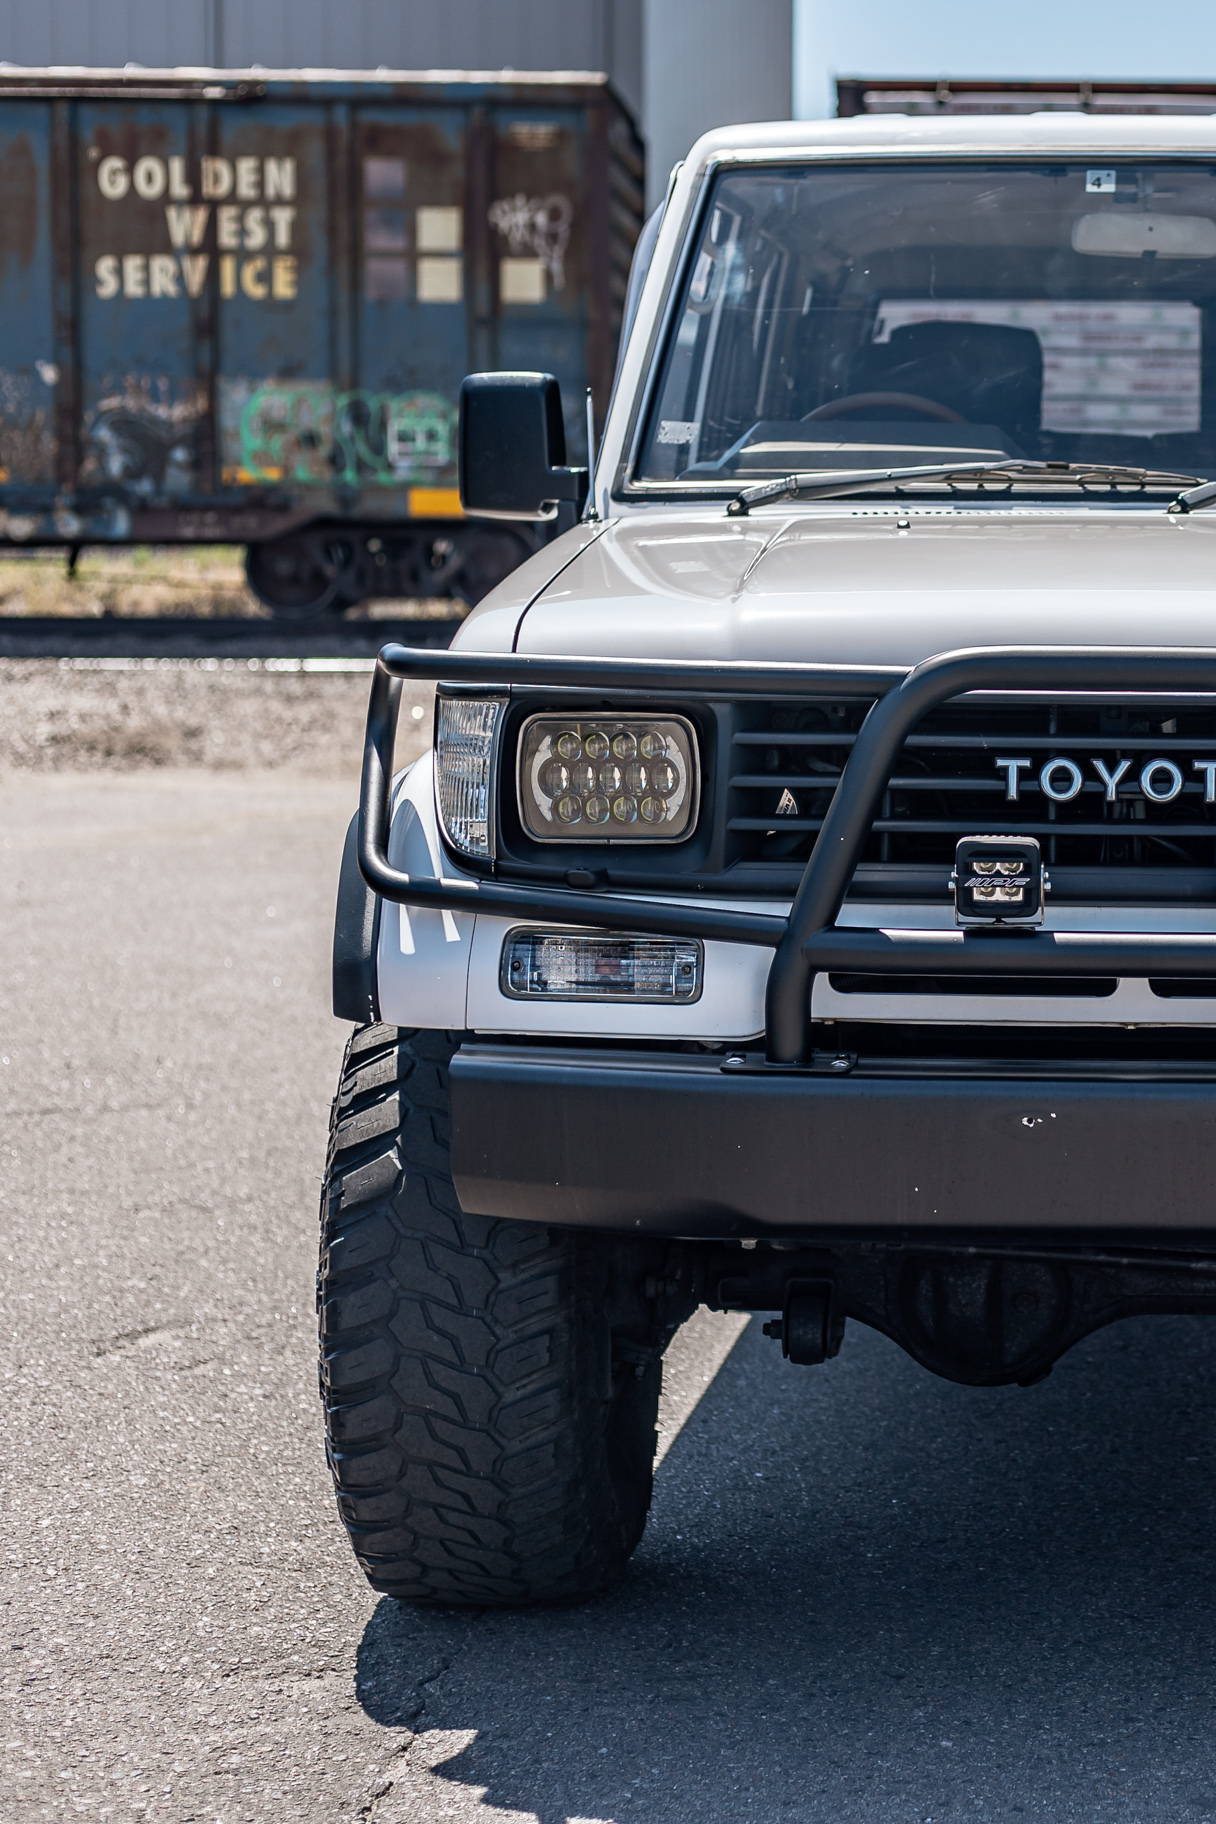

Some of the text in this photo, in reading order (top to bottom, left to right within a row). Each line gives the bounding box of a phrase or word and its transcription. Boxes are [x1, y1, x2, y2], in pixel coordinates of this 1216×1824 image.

[97, 155, 297, 200] GOLDEN
[1091, 176, 1102, 189] 4
[165, 204, 297, 250] WEST
[95, 253, 298, 300] SERVICE
